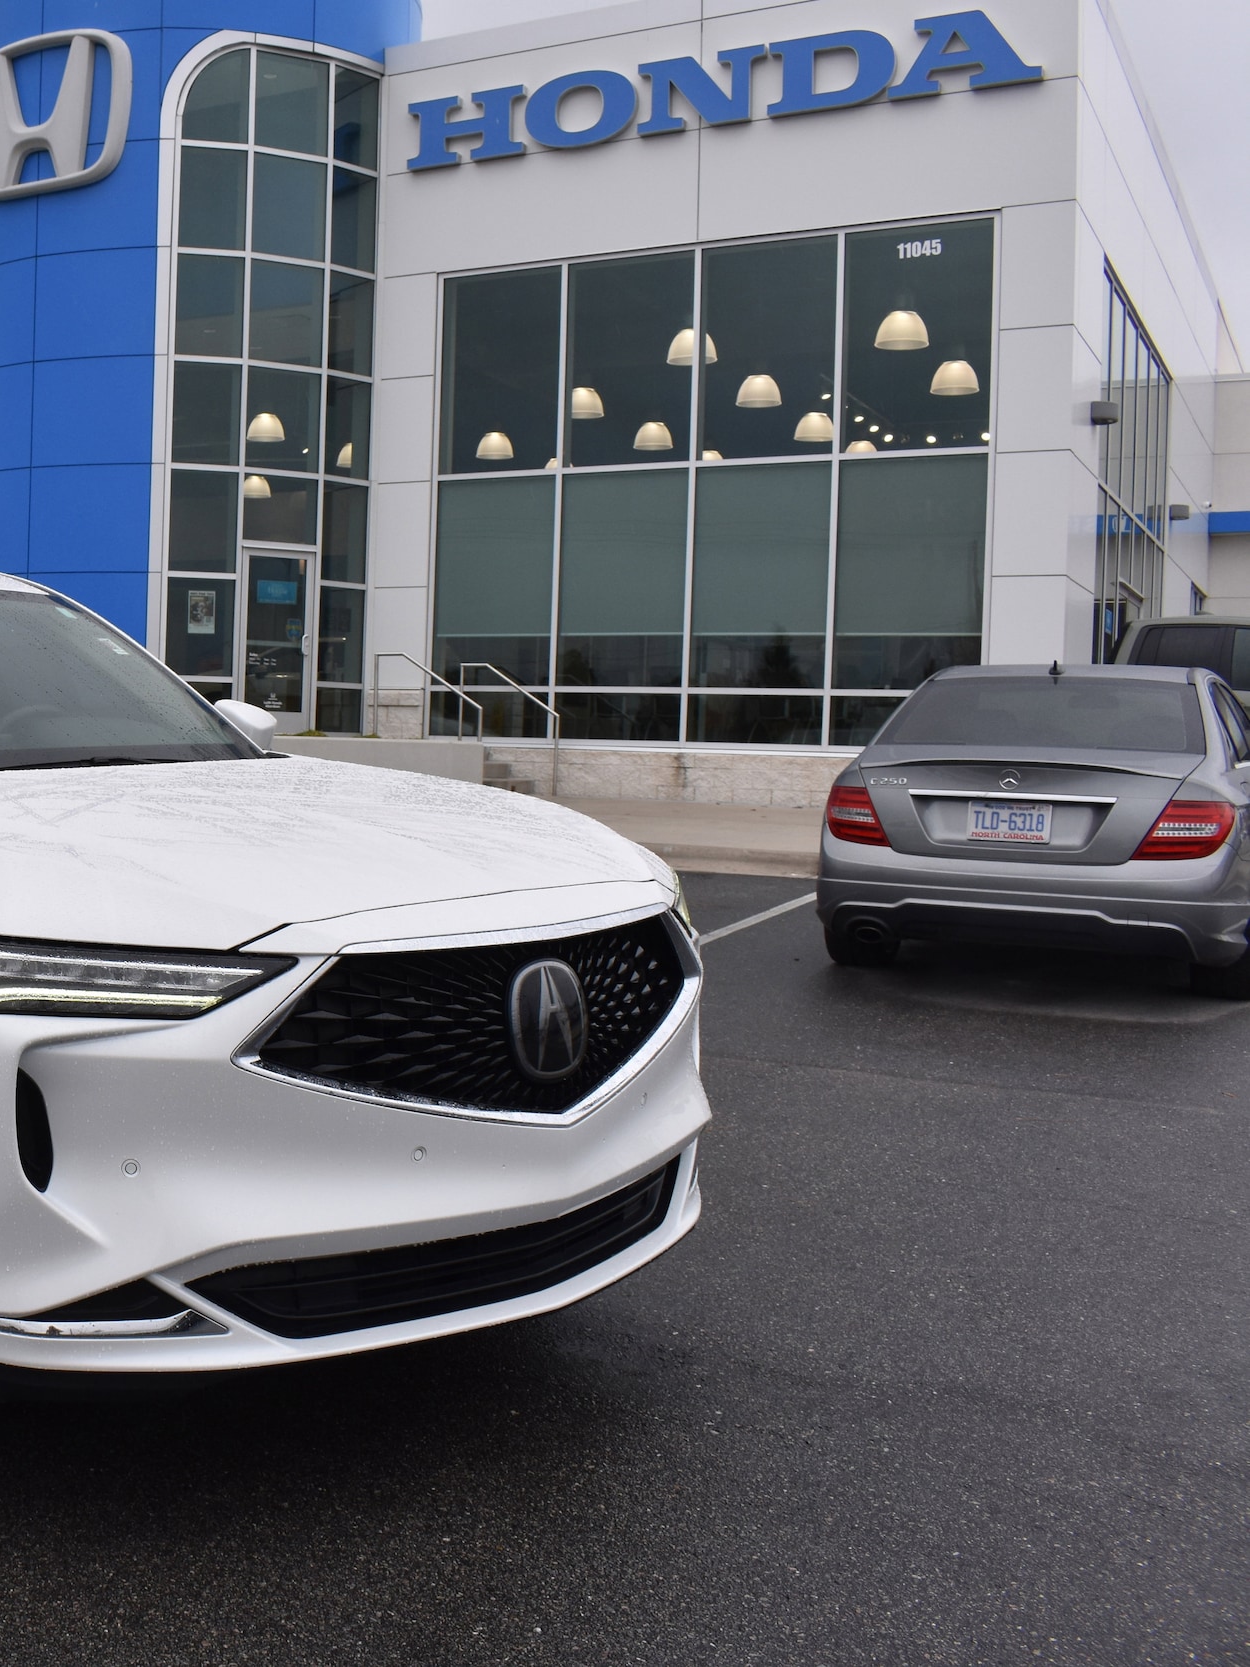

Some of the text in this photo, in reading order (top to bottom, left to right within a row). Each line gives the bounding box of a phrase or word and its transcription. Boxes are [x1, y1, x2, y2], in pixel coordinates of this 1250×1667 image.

[407, 9, 1043, 172] HONDA
[897, 239, 942, 259] 11045
[974, 810, 1045, 832] TLD-6318
[971, 831, 1045, 841] NORTH CAROLINA
